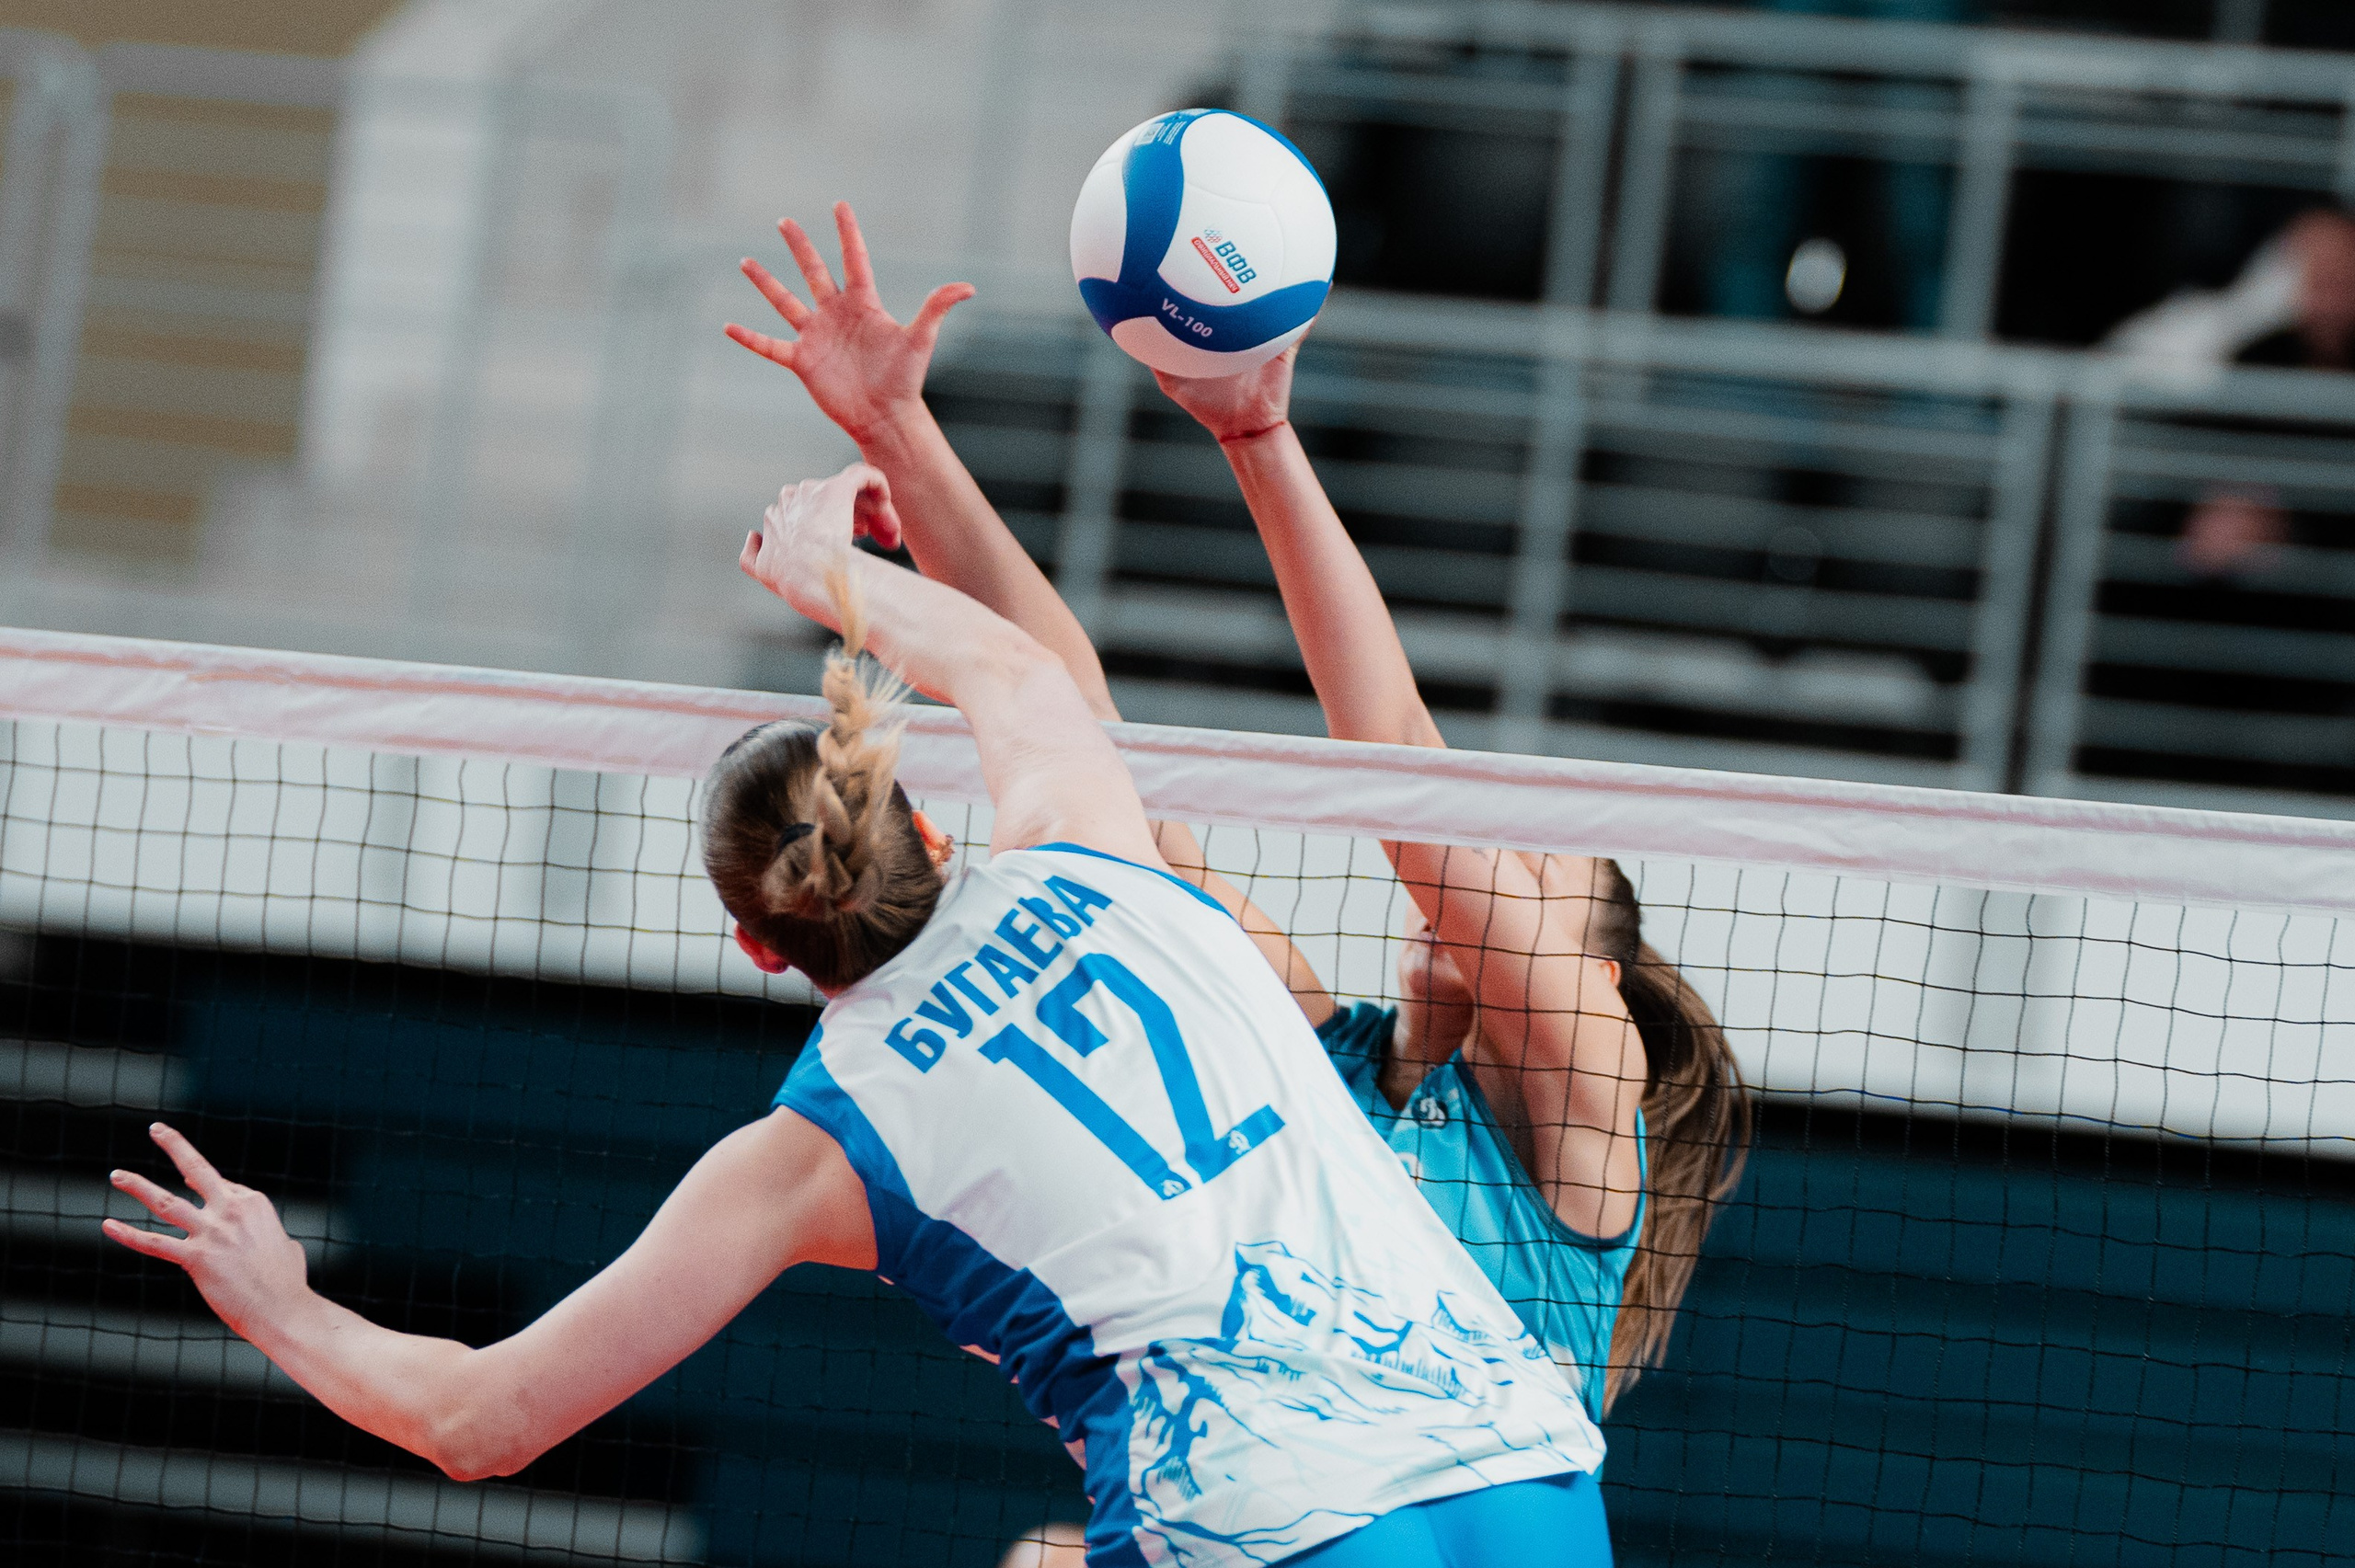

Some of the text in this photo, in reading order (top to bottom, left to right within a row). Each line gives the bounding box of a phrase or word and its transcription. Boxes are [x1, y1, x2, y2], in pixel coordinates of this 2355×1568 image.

[1162, 298, 1212, 337] VL-100
[1214, 241, 1257, 283] ВФВ
[884, 876, 1113, 1073] БУГАЕВА
[977, 953, 1286, 1201] 12
